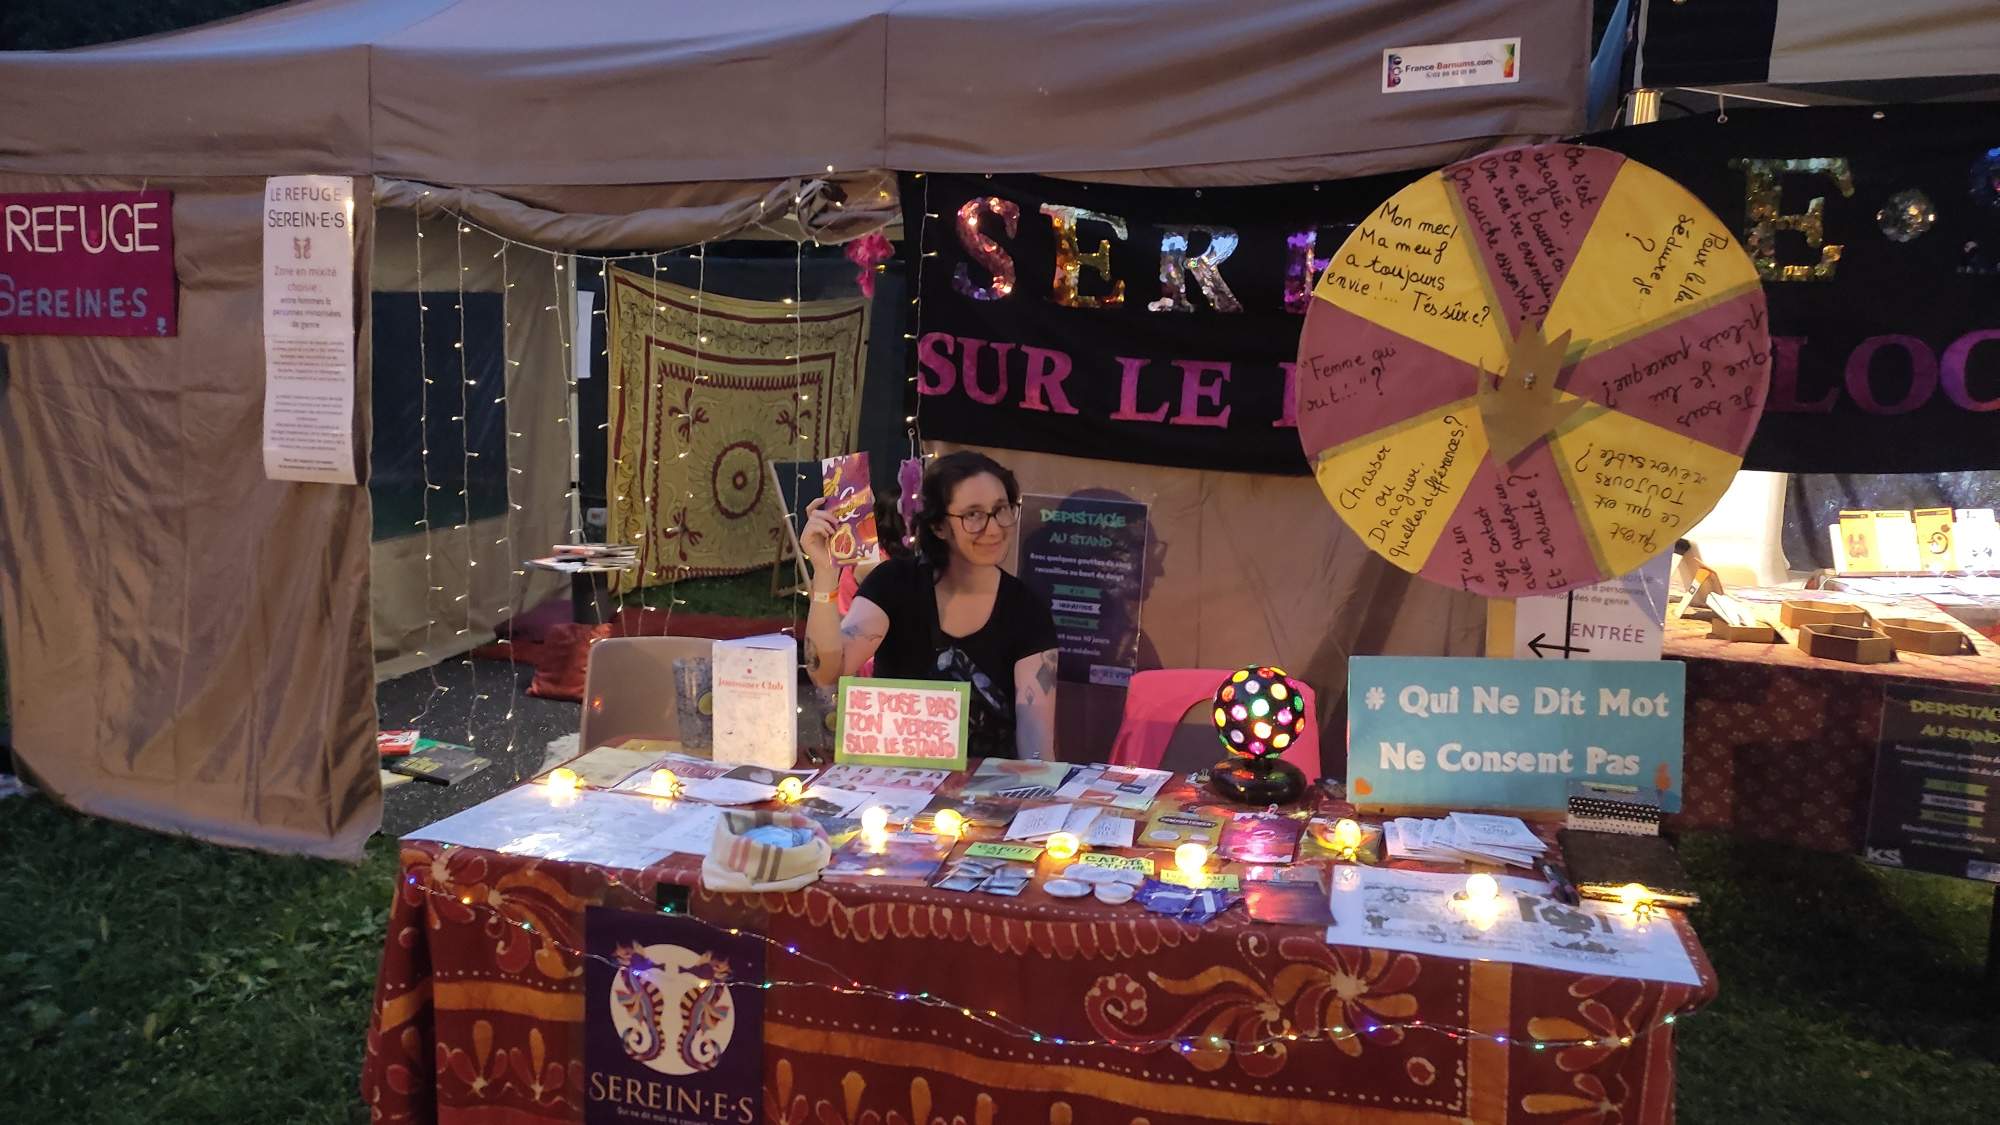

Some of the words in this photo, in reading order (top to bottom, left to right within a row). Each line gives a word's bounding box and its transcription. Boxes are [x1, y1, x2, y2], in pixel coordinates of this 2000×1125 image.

[271, 188, 282, 202] LE
[284, 186, 342, 202] REFUGE
[4, 202, 160, 254] REFUGE
[1379, 201, 1412, 229] Mon
[1467, 196, 1501, 250] couche
[1360, 228, 1389, 248] Ma
[1395, 241, 1449, 264] meuf
[1651, 214, 1695, 281] séduire
[1694, 232, 1728, 267] Pour
[1327, 271, 1370, 296] envie
[1346, 253, 1360, 267] a
[1364, 257, 1446, 291] toujours
[1372, 346, 1397, 373] qui
[1726, 344, 1767, 377] que
[917, 331, 1079, 415] SUR
[1109, 356, 1232, 429] LE
[1340, 445, 1391, 510] Chasser
[1595, 472, 1685, 506] TOUJOURS
[1375, 485, 1396, 507] ou
[1594, 494, 1617, 510] est
[1626, 494, 1653, 519] qui
[1452, 525, 1468, 545] un
[1520, 488, 1556, 559] ensuite
[1049, 531, 1068, 545] AU
[1070, 534, 1113, 548] STAND
[1494, 559, 1520, 592] eye
[1518, 556, 1537, 590] avec
[1547, 568, 1568, 589] Et
[1570, 622, 1646, 644] ENTRÉE
[850, 690, 873, 711] NE
[878, 691, 922, 716] POSE
[1398, 685, 1460, 718] Qui
[1472, 686, 1521, 716] Ne
[1534, 687, 1586, 716] Dit
[1597, 688, 1671, 719] Mot
[846, 711, 883, 734] TON
[893, 718, 950, 740] VERRE
[1920, 723, 1944, 738] AU
[845, 734, 881, 755] SUR
[883, 737, 900, 755] LE
[901, 736, 957, 759] STAND
[1378, 742, 1427, 771] Ne
[1436, 743, 1574, 774] Consent
[1586, 747, 1641, 776] Pas
